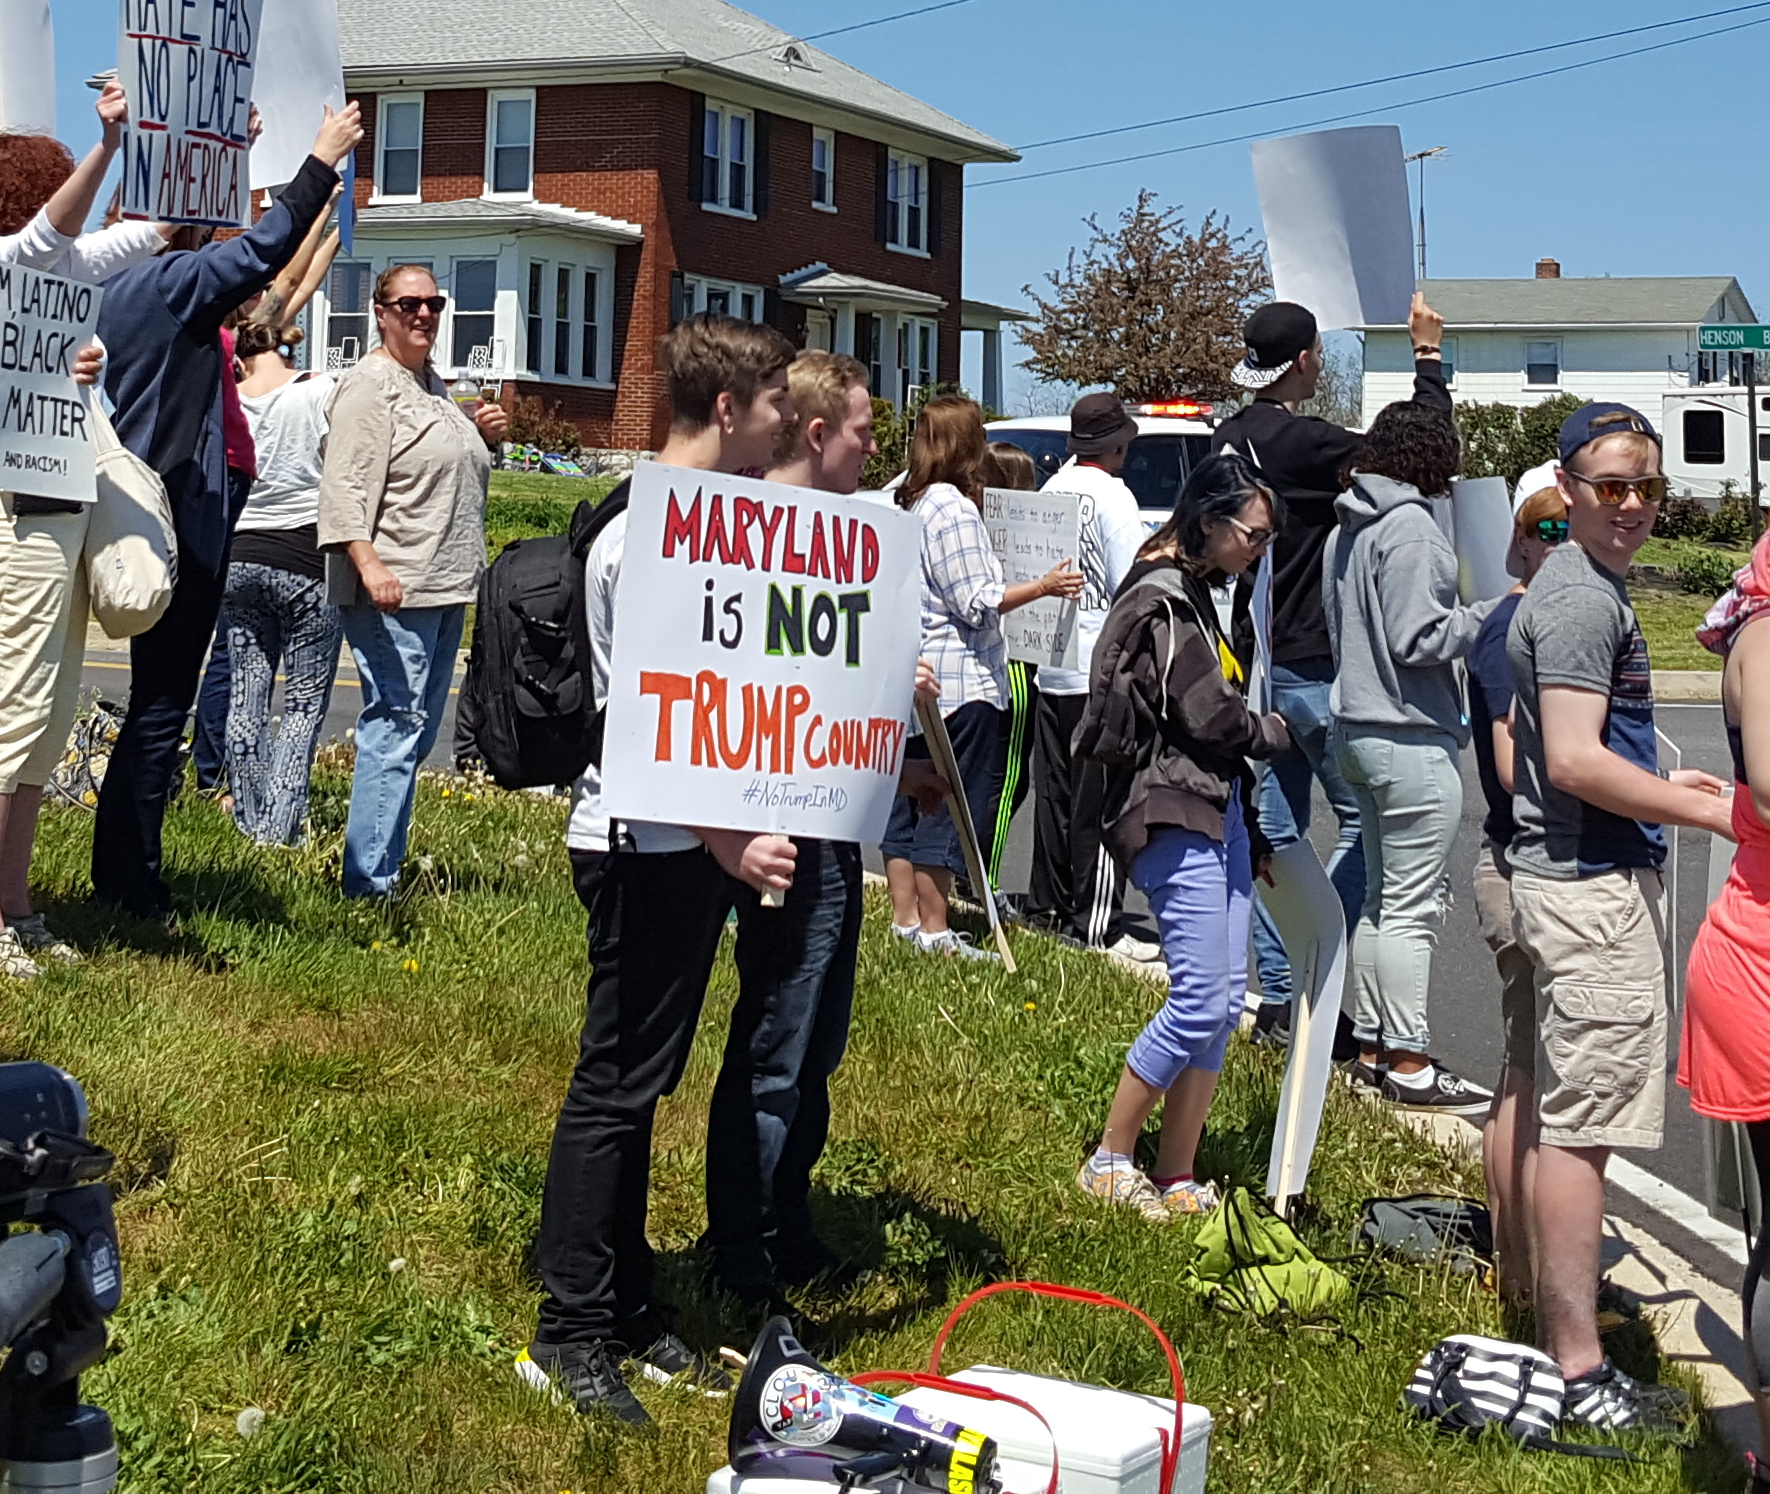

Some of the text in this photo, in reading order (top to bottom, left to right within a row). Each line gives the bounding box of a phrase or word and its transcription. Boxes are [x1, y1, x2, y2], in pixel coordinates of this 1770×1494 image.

[137, 37, 252, 143] NO PLACE
[121, 130, 239, 220] IN AMERICA
[21, 272, 92, 324] LATINO
[0, 321, 77, 378] BLACK
[1700, 329, 1745, 346] HENSON
[1, 385, 89, 442] MATTER
[3, 450, 23, 469] AND
[24, 454, 68, 477] RACISM!
[986, 492, 1004, 519] FEAR
[661, 485, 881, 585] MARYLAND
[989, 527, 1008, 556] NGER
[764, 580, 872, 669] NOT
[639, 669, 907, 777] TRUMP COUNTRY
